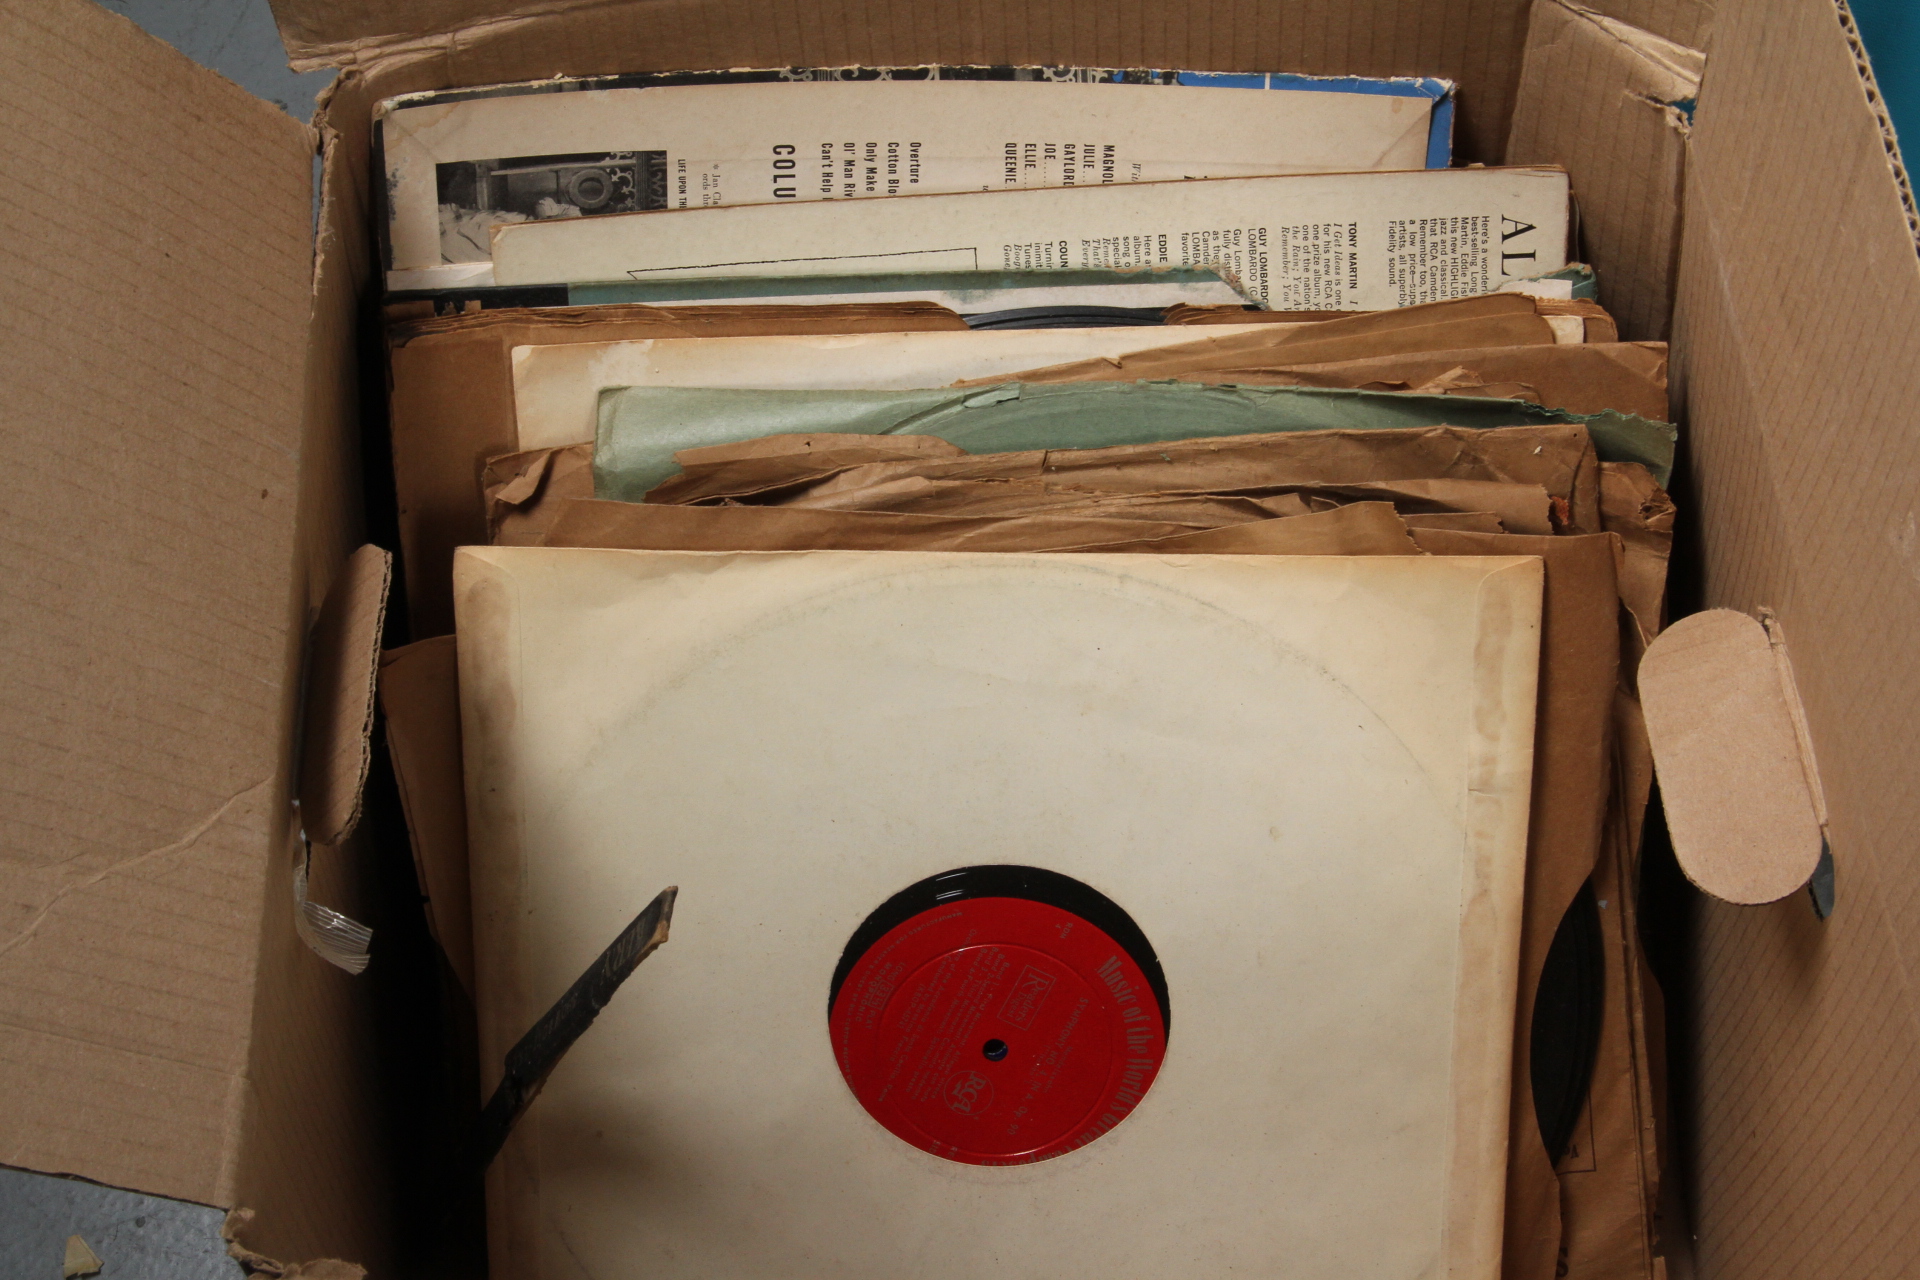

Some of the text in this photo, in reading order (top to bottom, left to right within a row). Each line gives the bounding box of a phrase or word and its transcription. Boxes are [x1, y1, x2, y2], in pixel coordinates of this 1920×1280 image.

[678, 159, 687, 173] LIFE
[821, 143, 834, 168] Can't
[863, 142, 878, 192] Only Make
[909, 142, 922, 184] Overture
[1102, 144, 1116, 184] MAGNOL
[711, 173, 721, 188] Jan
[772, 145, 797, 198] COLU
[843, 143, 856, 198] Ol' Man Riv
[887, 142, 900, 197] Cotton Blo
[679, 176, 687, 195] UPON
[703, 173, 711, 191] ords
[820, 172, 834, 193] Help
[1212, 230, 1220, 241] as
[1258, 227, 1268, 247] GUY
[1292, 226, 1301, 240] the
[1302, 224, 1310, 241] one
[1312, 224, 1320, 241] one
[1322, 223, 1332, 237] for
[1348, 221, 1358, 248] TONY
[1450, 217, 1460, 234] this
[1460, 216, 1470, 249] Martin,
[1481, 215, 1491, 245] Here's
[1122, 236, 1131, 258] song
[1143, 235, 1152, 257] Here
[1158, 234, 1168, 263] EDDIE
[1191, 232, 1201, 265] LOMBA
[1221, 230, 1232, 249] fully
[1232, 229, 1242, 247] Guy
[1303, 245, 1311, 254] of
[1323, 240, 1332, 254] his
[1334, 231, 1343, 247] Get
[1409, 231, 1418, 247] low
[1419, 219, 1429, 267] Remember
[1450, 236, 1459, 254] new
[1501, 214, 1537, 277] AL
[1024, 242, 1033, 269] Tunes
[1059, 240, 1069, 268] COUN
[1092, 238, 1102, 268] That's
[1248, 228, 1258, 282] LOMBARDO
[1281, 227, 1291, 280] Remember;
[1291, 245, 1301, 272] Rain;
[1311, 244, 1322, 266] prize
[1334, 250, 1343, 276] Ideas
[1386, 220, 1397, 288] Fidelity sound.
[1397, 220, 1408, 305] artists, all superbly
[1430, 218, 1439, 302] that RCA Camden
[1438, 217, 1449, 300] jazz and classical.
[1469, 216, 1480, 293] best-selling Long
[1303, 258, 1311, 273] the
[1324, 258, 1332, 276] new
[1348, 252, 1358, 289] MARTIN
[1460, 253, 1470, 278] Eddie
[1312, 269, 1322, 299] album,
[1324, 280, 1333, 299] RCA
[1334, 279, 1343, 287] is
[1418, 271, 1428, 288] too,
[1282, 284, 1291, 302] You
[1058, 920, 1074, 940] RDM
[885, 961, 906, 982] LONG
[1093, 955, 1139, 1005] Music
[1005, 990, 1027, 1018] Digest
[1012, 972, 1050, 1023] Reader's
[863, 1008, 877, 1030] PLAY
[1053, 996, 1089, 1049] SYMPHONY
[1121, 1007, 1151, 1023] of
[1125, 1028, 1154, 1052] the
[1042, 1049, 1060, 1068] NO.
[949, 1071, 989, 1114] RCA
[1029, 1080, 1042, 1092] IN
[1005, 1122, 1019, 1136] 90
